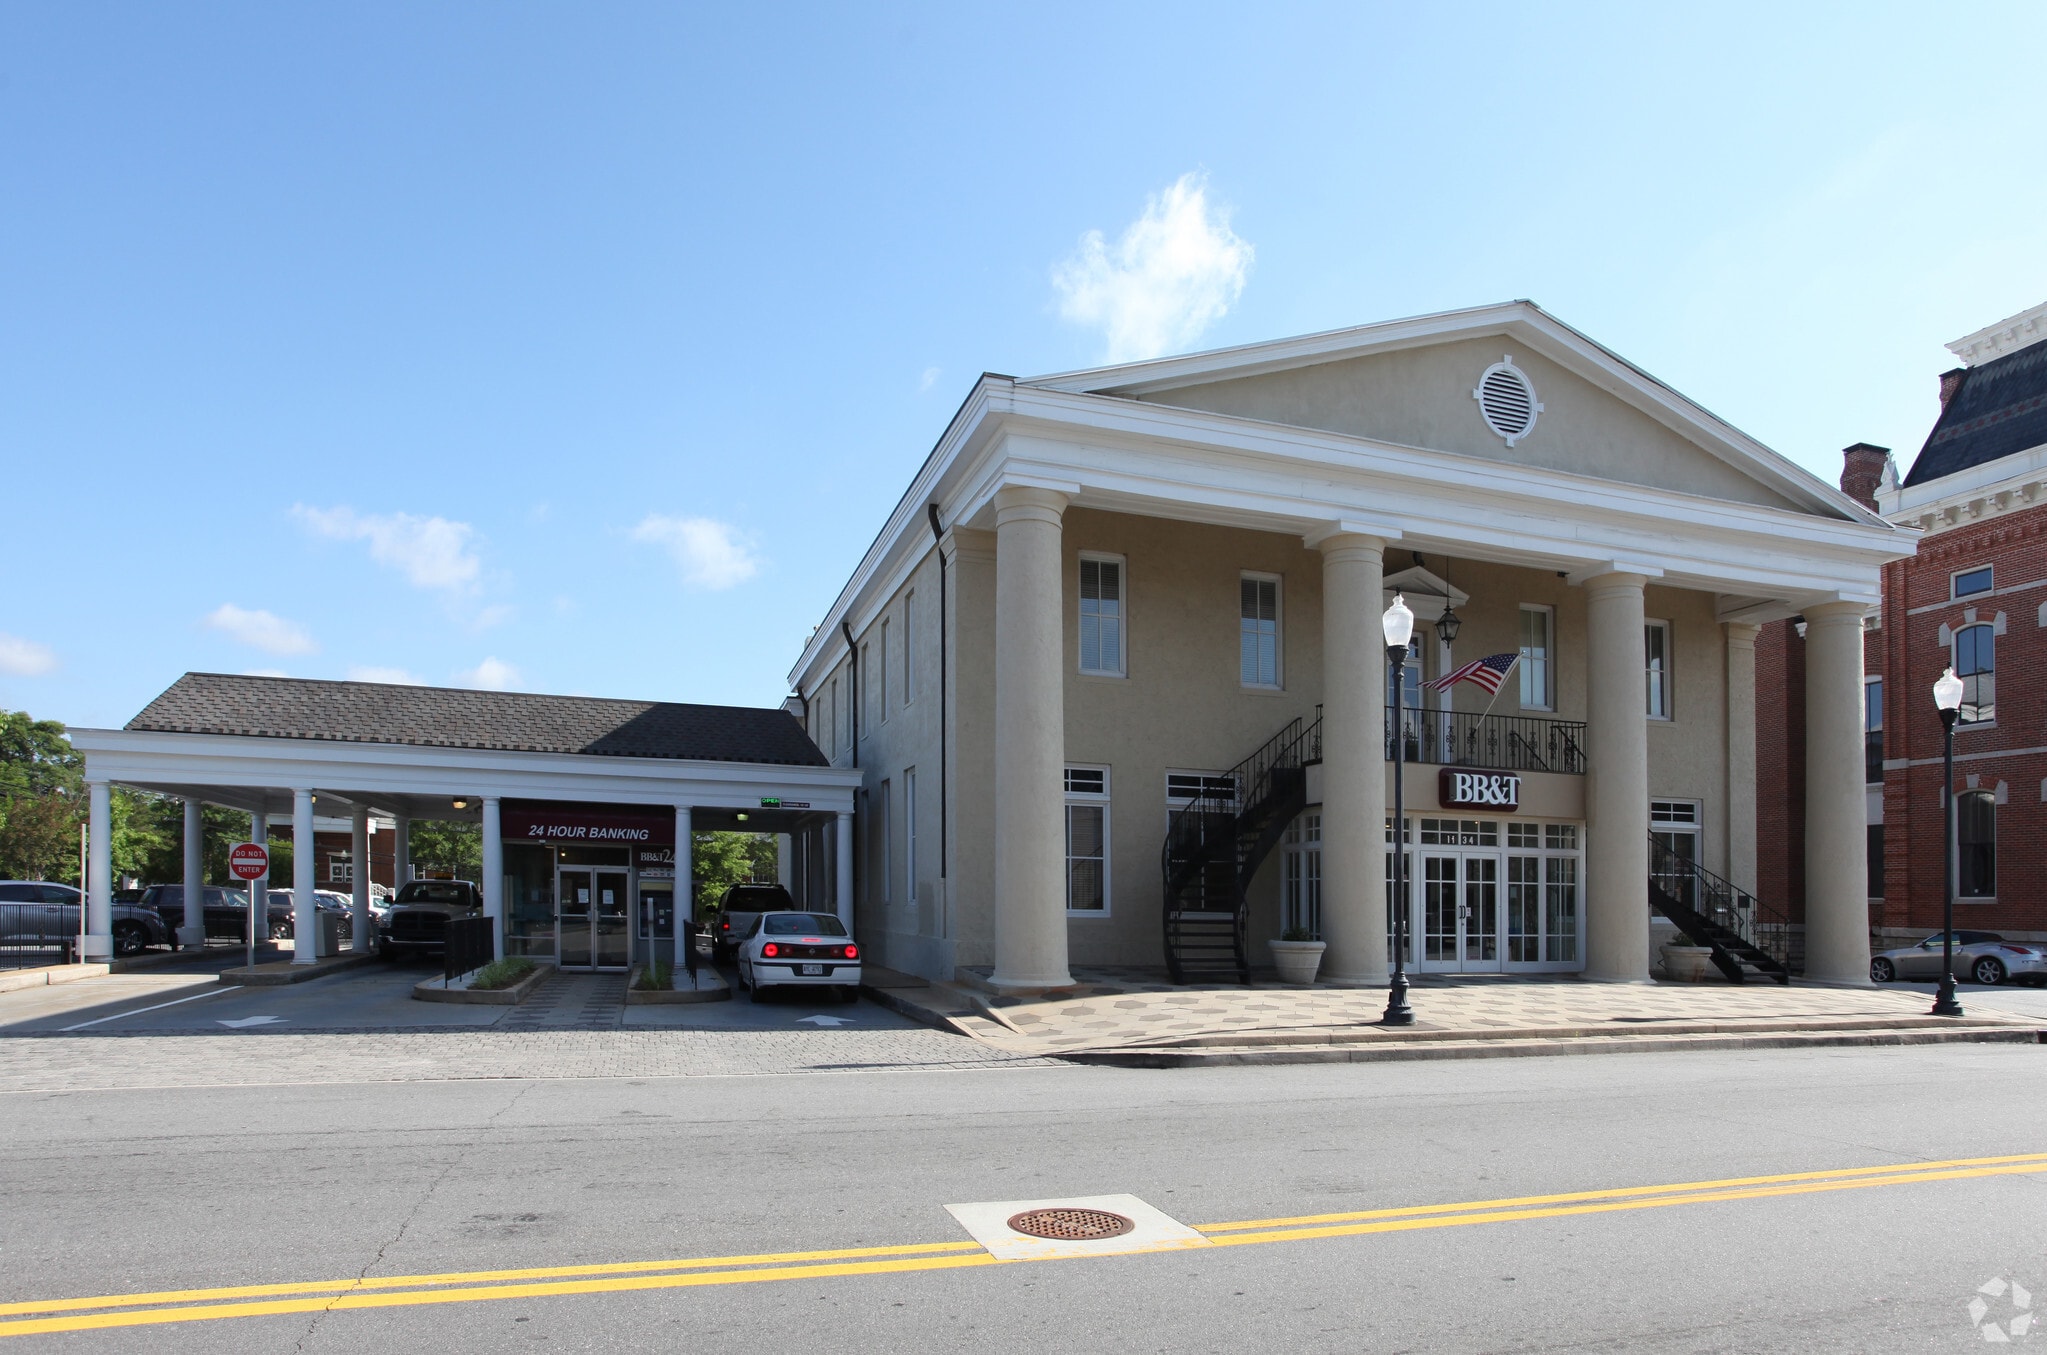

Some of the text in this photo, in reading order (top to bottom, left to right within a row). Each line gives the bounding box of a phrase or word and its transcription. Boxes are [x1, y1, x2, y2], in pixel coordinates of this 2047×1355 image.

[1453, 773, 1522, 805] BB&T
[528, 825, 649, 840] 24 HOUR BANKING
